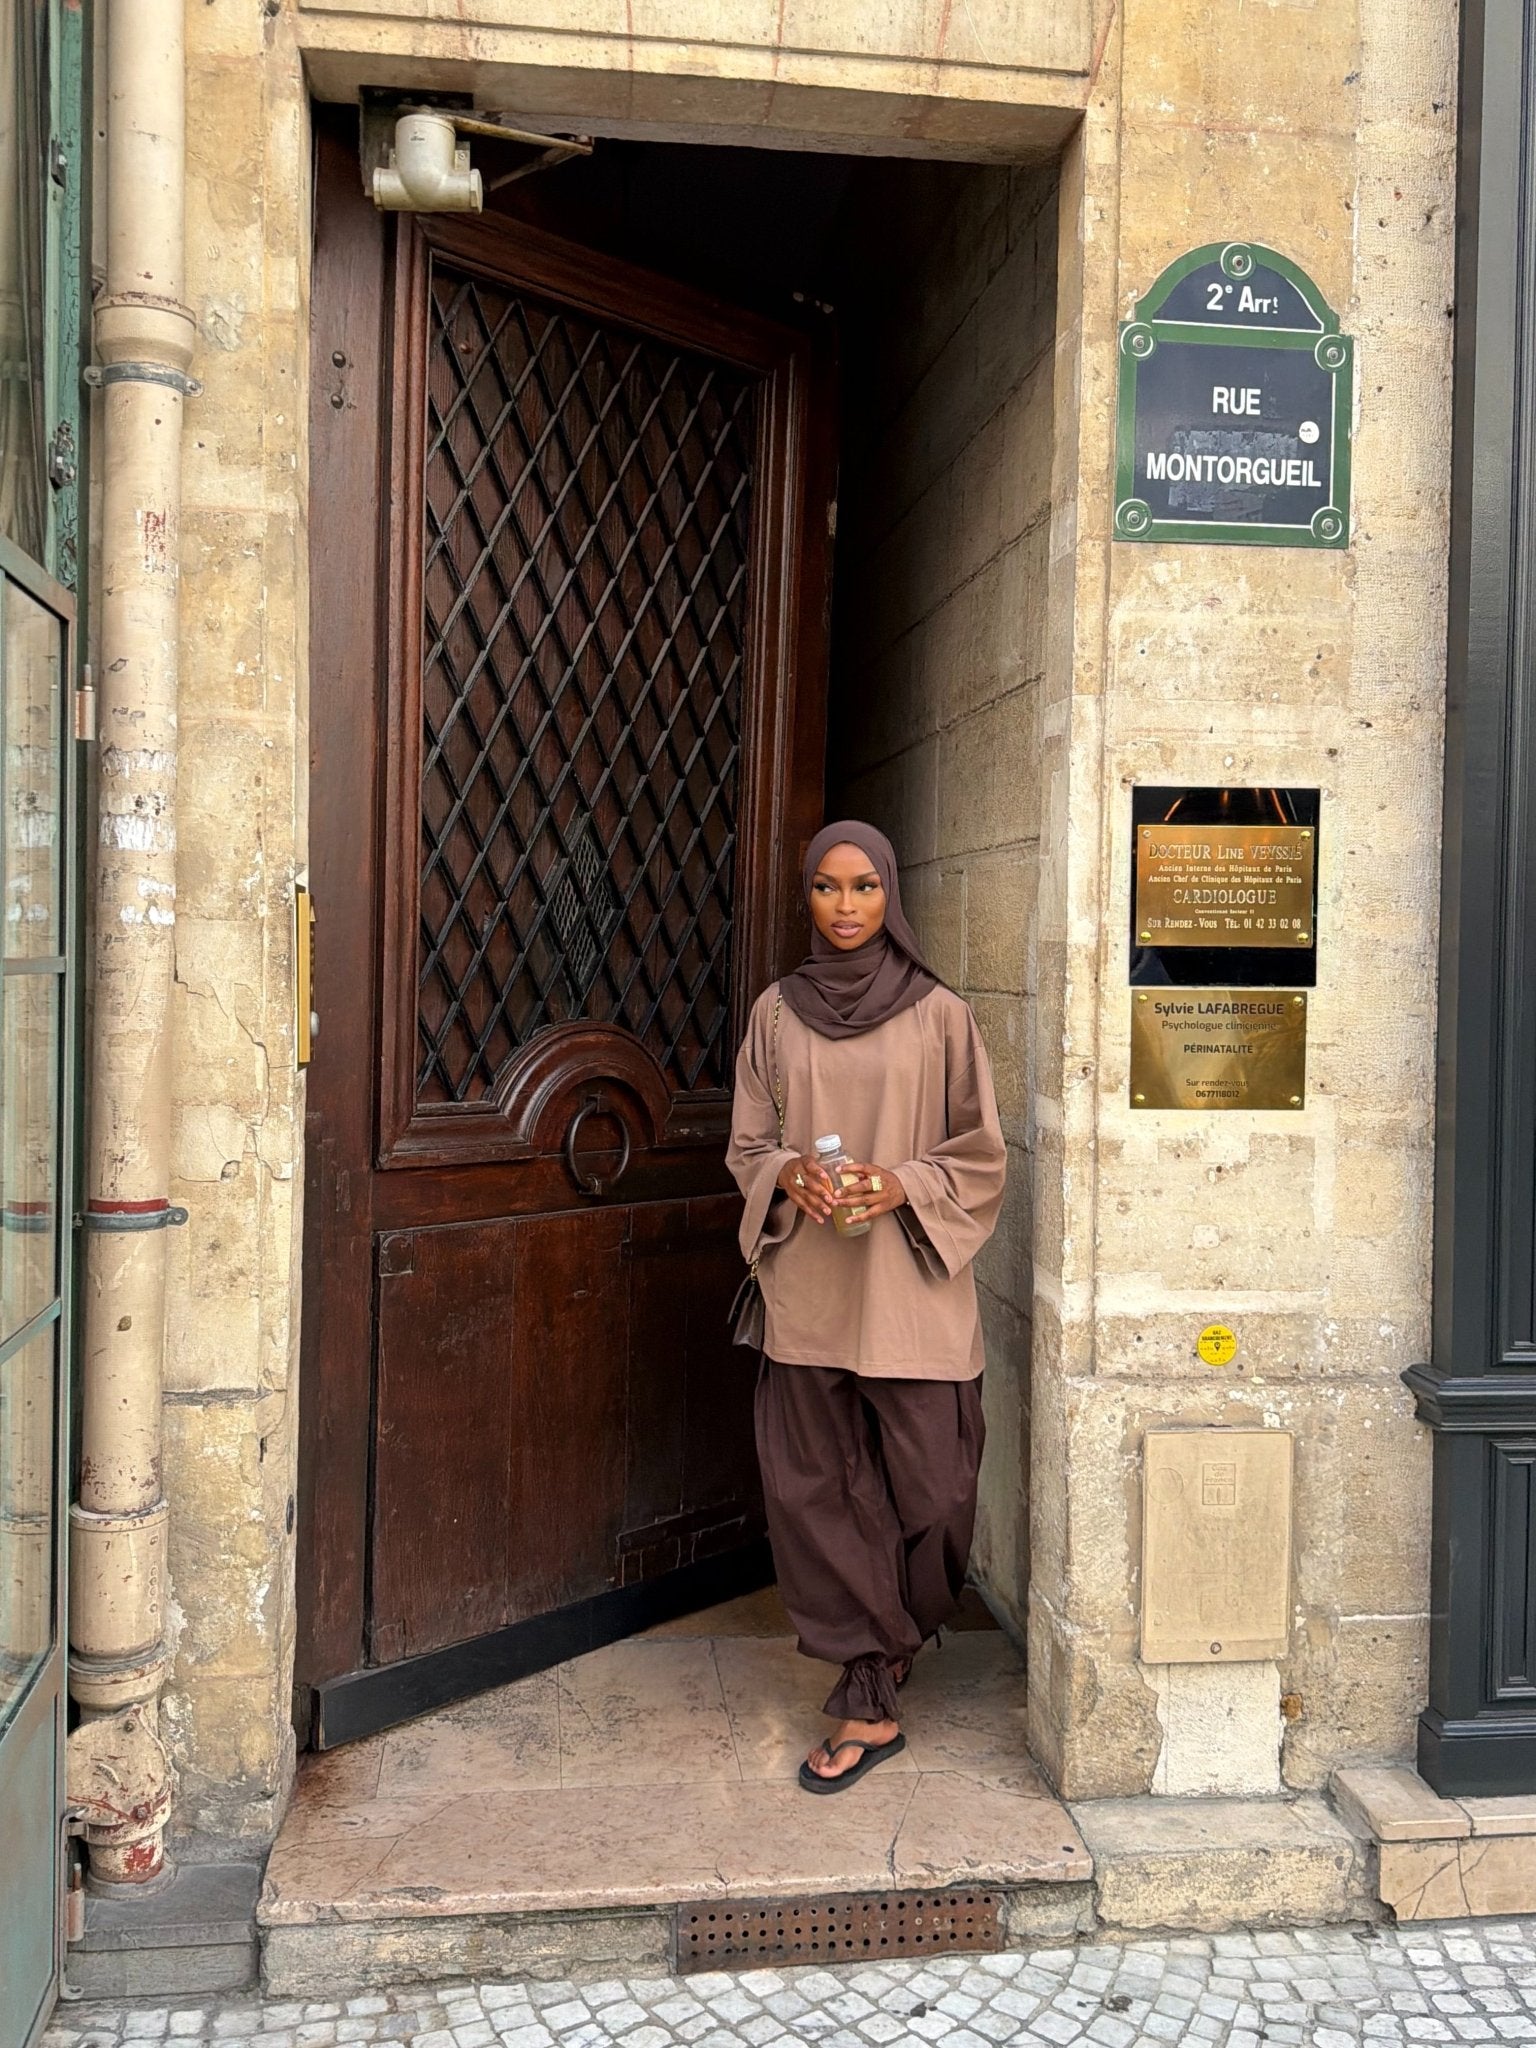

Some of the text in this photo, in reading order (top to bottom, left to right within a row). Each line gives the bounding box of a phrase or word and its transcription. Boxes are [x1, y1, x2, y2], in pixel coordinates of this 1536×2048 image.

[1212, 386, 1261, 415] RUE
[1146, 453, 1322, 487] MONTORGUEIL
[1149, 844, 1211, 859] DOCTEUR
[1158, 864, 1183, 872] Ancien
[1214, 864, 1226, 872] des
[1275, 865, 1293, 873] Paris
[1201, 875, 1229, 884] Clinique
[1286, 876, 1302, 884] Paris
[1173, 889, 1277, 904] CARDIOLOGUE
[1243, 918, 1252, 929] 01
[1256, 918, 1265, 929] 42
[1268, 918, 1277, 929] 33
[1280, 918, 1289, 930] 02
[1292, 918, 1301, 930] 08
[1154, 1003, 1285, 1017] Sylvie LAFABREGUE
[1162, 1021, 1277, 1032] Psychologue clinicienne
[1186, 1079, 1200, 1087] Sur
